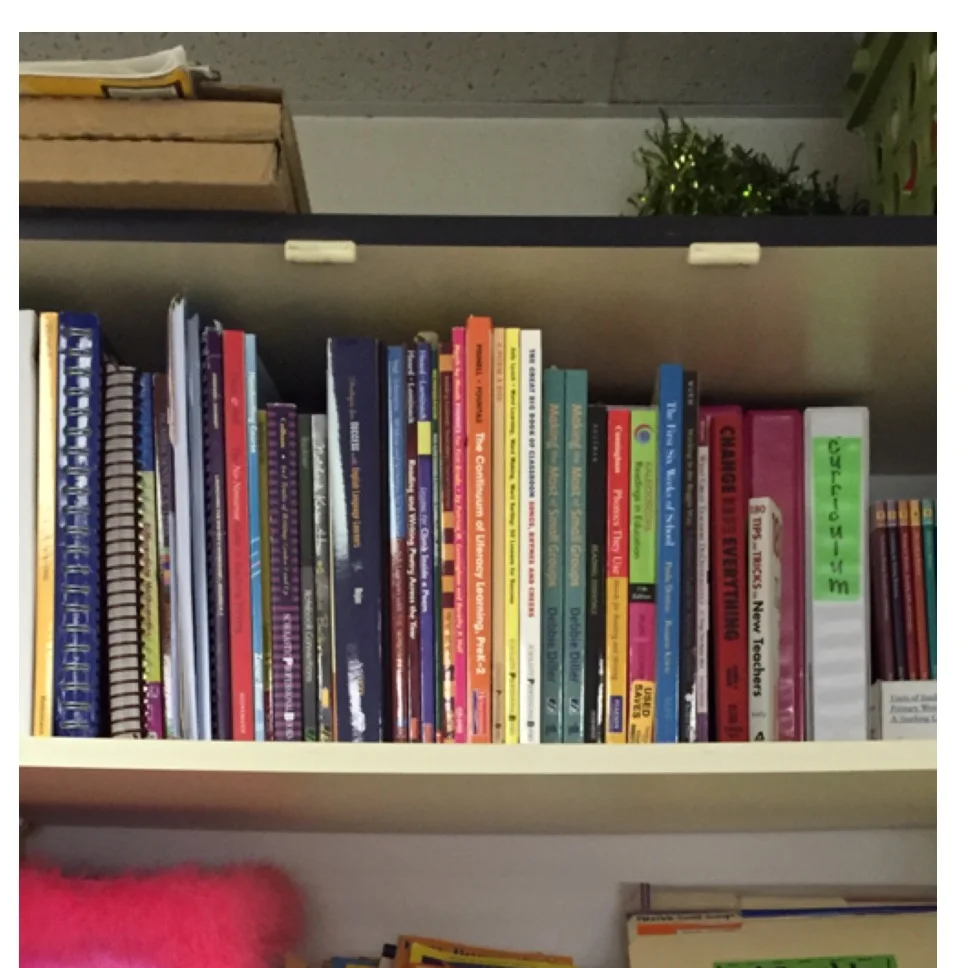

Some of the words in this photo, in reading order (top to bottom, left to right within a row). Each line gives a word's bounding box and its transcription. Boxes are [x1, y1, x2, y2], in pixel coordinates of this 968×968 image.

[407, 349, 416, 376] Heard
[418, 349, 427, 376] Heard
[528, 349, 536, 364] THE
[528, 366, 536, 393] GREAT
[407, 382, 417, 424] Laminack
[528, 396, 536, 411] BIG
[666, 401, 676, 422] The
[349, 421, 360, 451] SUCCESS
[528, 413, 536, 436] BOOK
[545, 403, 560, 450] Making
[567, 403, 583, 450] Making
[666, 424, 677, 447] First
[475, 432, 486, 451] The
[528, 438, 536, 448] OF
[613, 424, 623, 473] Cunningham
[666, 449, 676, 464] Six
[528, 450, 536, 498] CLASSROOM
[719, 425, 737, 494] CHANGE
[406, 459, 416, 492] Reading
[475, 455, 486, 517] Continuum
[548, 466, 560, 497] Most
[570, 466, 582, 497] Most
[632, 461, 643, 502] Readings
[665, 468, 676, 498] Weeks
[408, 496, 417, 511] and
[527, 501, 536, 530] SONGS,
[611, 488, 623, 527] Phonics
[634, 504, 643, 513] in
[665, 500, 676, 512] of
[406, 513, 417, 546] Writing
[475, 520, 485, 531] of
[548, 509, 560, 543] Small
[570, 509, 582, 543] Small
[634, 515, 644, 560] Education
[664, 513, 675, 547] School
[752, 517, 762, 541] TIPS
[474, 534, 486, 579] Literacy
[528, 532, 536, 565] RHYMES
[610, 530, 623, 554] They
[407, 547, 418, 575] Poetry
[420, 554, 430, 579] Inside
[528, 567, 536, 584] AND
[545, 544, 560, 587] Groups
[568, 544, 582, 587] Groups
[611, 556, 623, 575] Use
[752, 551, 763, 590] TRICKS
[409, 577, 418, 605] Across
[421, 589, 431, 613] Poem
[528, 587, 536, 618] CHEERS
[722, 537, 740, 641] EVERYTHING
[409, 605, 418, 619] the
[473, 582, 486, 634] Learning,
[752, 600, 764, 633] New
[409, 621, 418, 639] Year
[547, 607, 559, 650] Debbie
[569, 607, 581, 650] Debbie
[547, 652, 559, 683] Diller
[569, 652, 581, 683] Diller
[752, 637, 765, 697] Teachers
[633, 683, 643, 719] SAVES
[643, 687, 653, 718] USED
